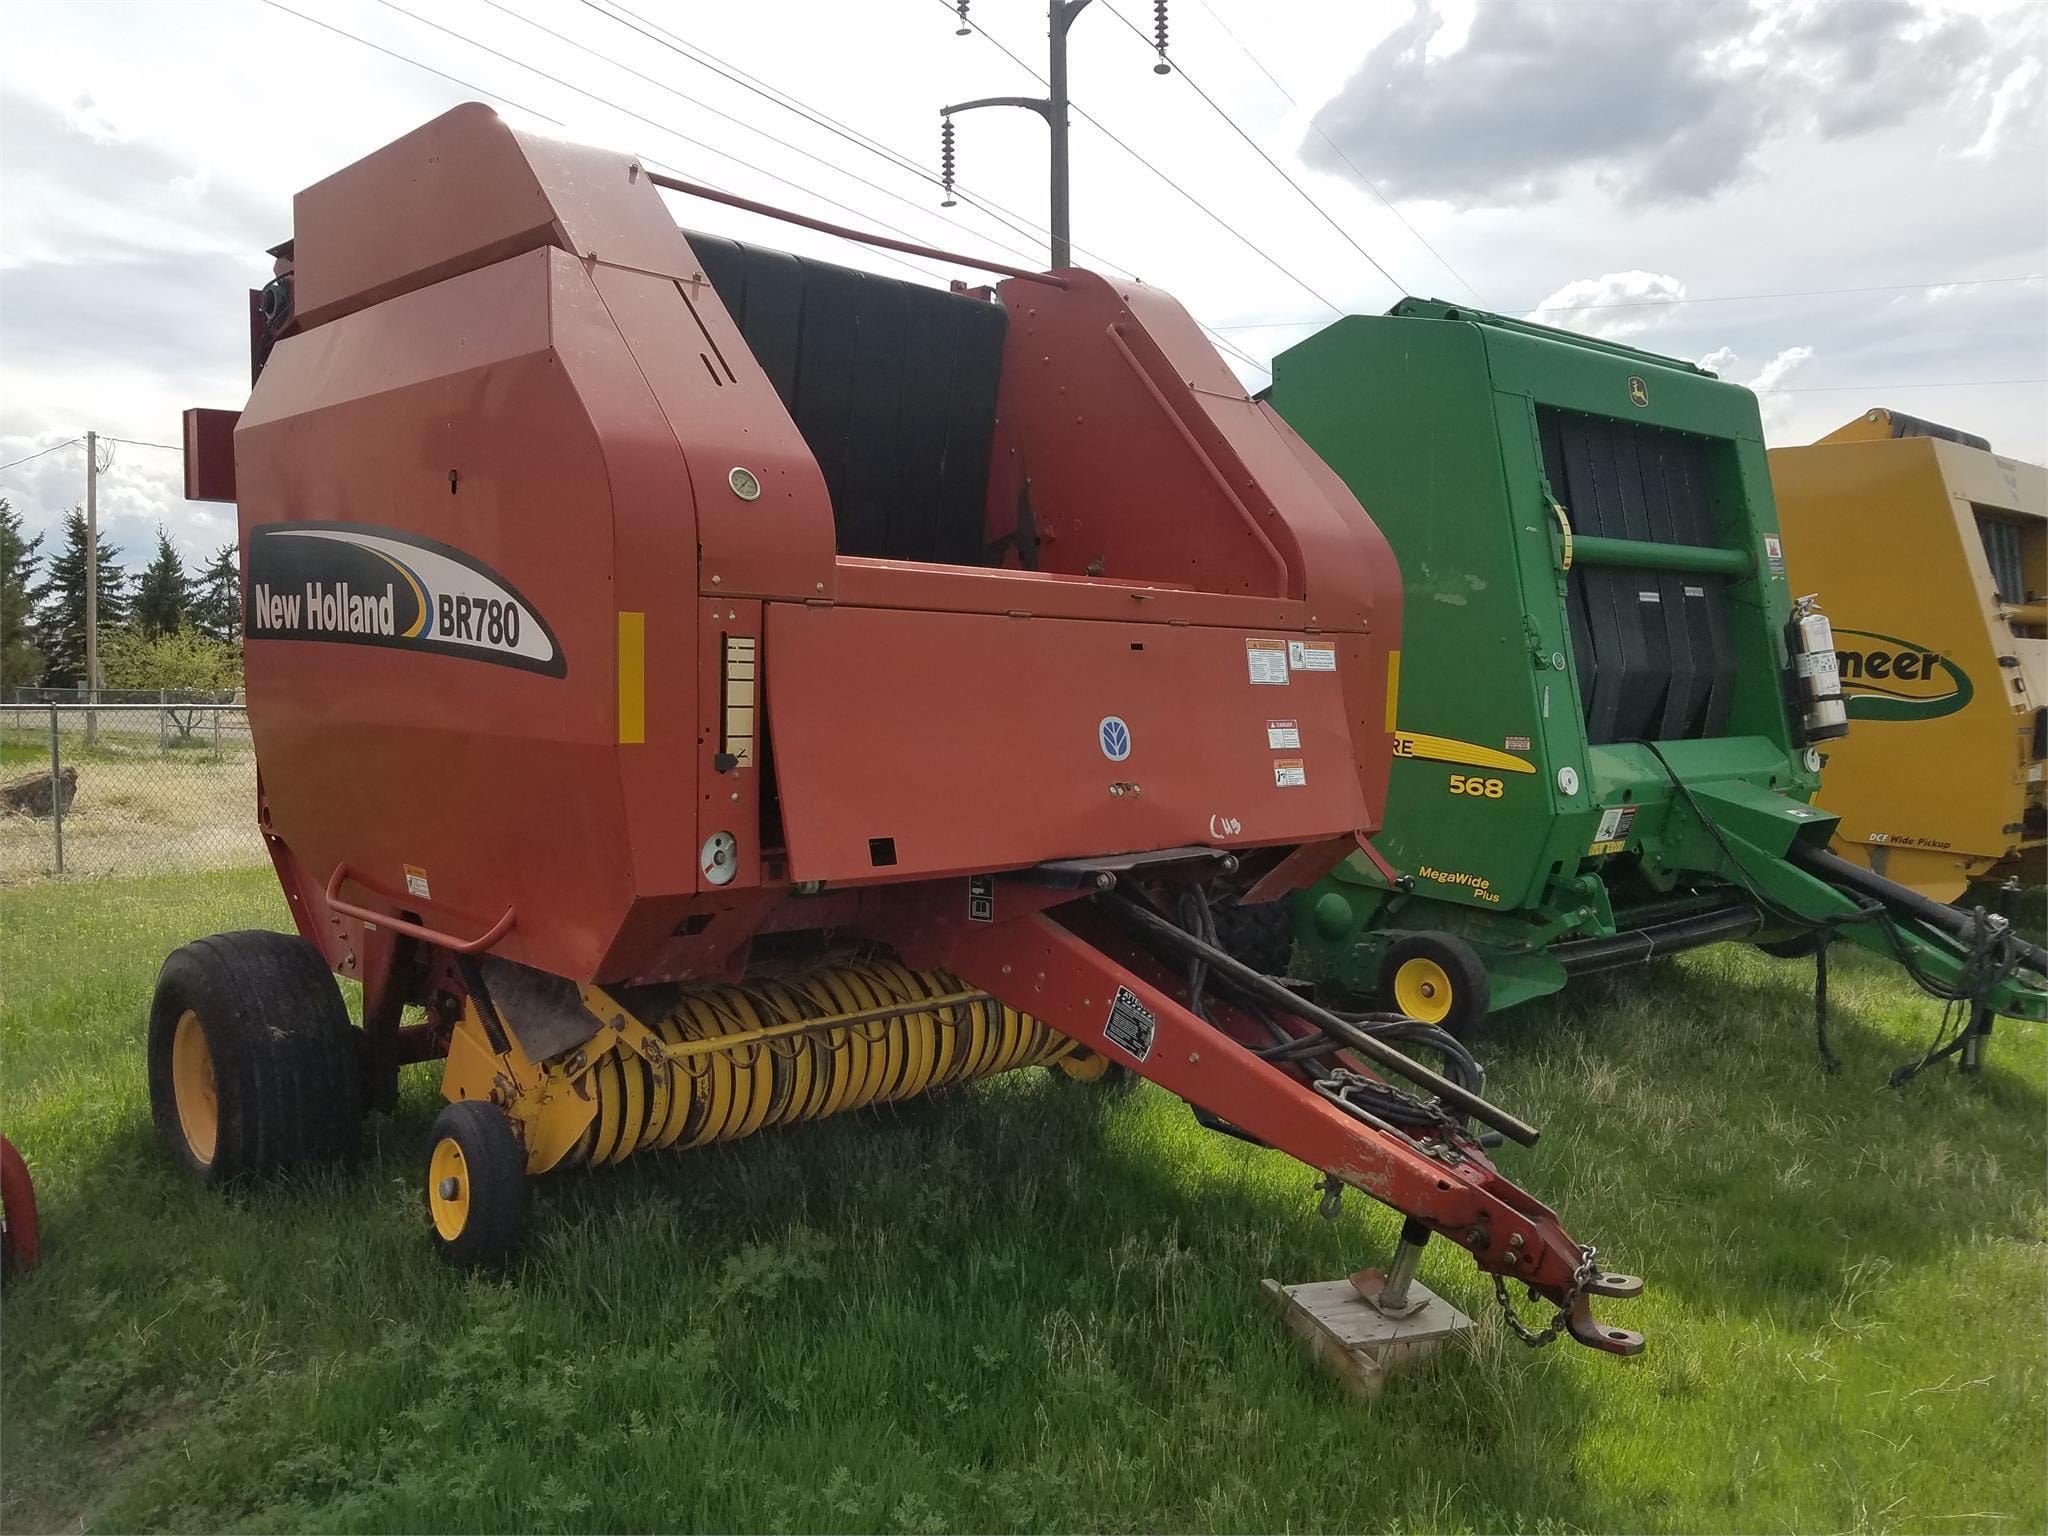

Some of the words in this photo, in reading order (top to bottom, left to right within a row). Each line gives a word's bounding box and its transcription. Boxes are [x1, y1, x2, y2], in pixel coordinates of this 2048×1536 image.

[256, 583, 300, 630] New
[306, 582, 394, 636] Holland
[438, 593, 519, 648] BR780
[1836, 650, 1941, 681] meer
[1449, 775, 1504, 798] 568
[1869, 833, 1889, 842] DCF
[1891, 835, 1914, 845] Wide
[1917, 838, 1951, 849] Pickup
[1418, 865, 1490, 890] MegaWide
[1473, 888, 1501, 903] Plus
